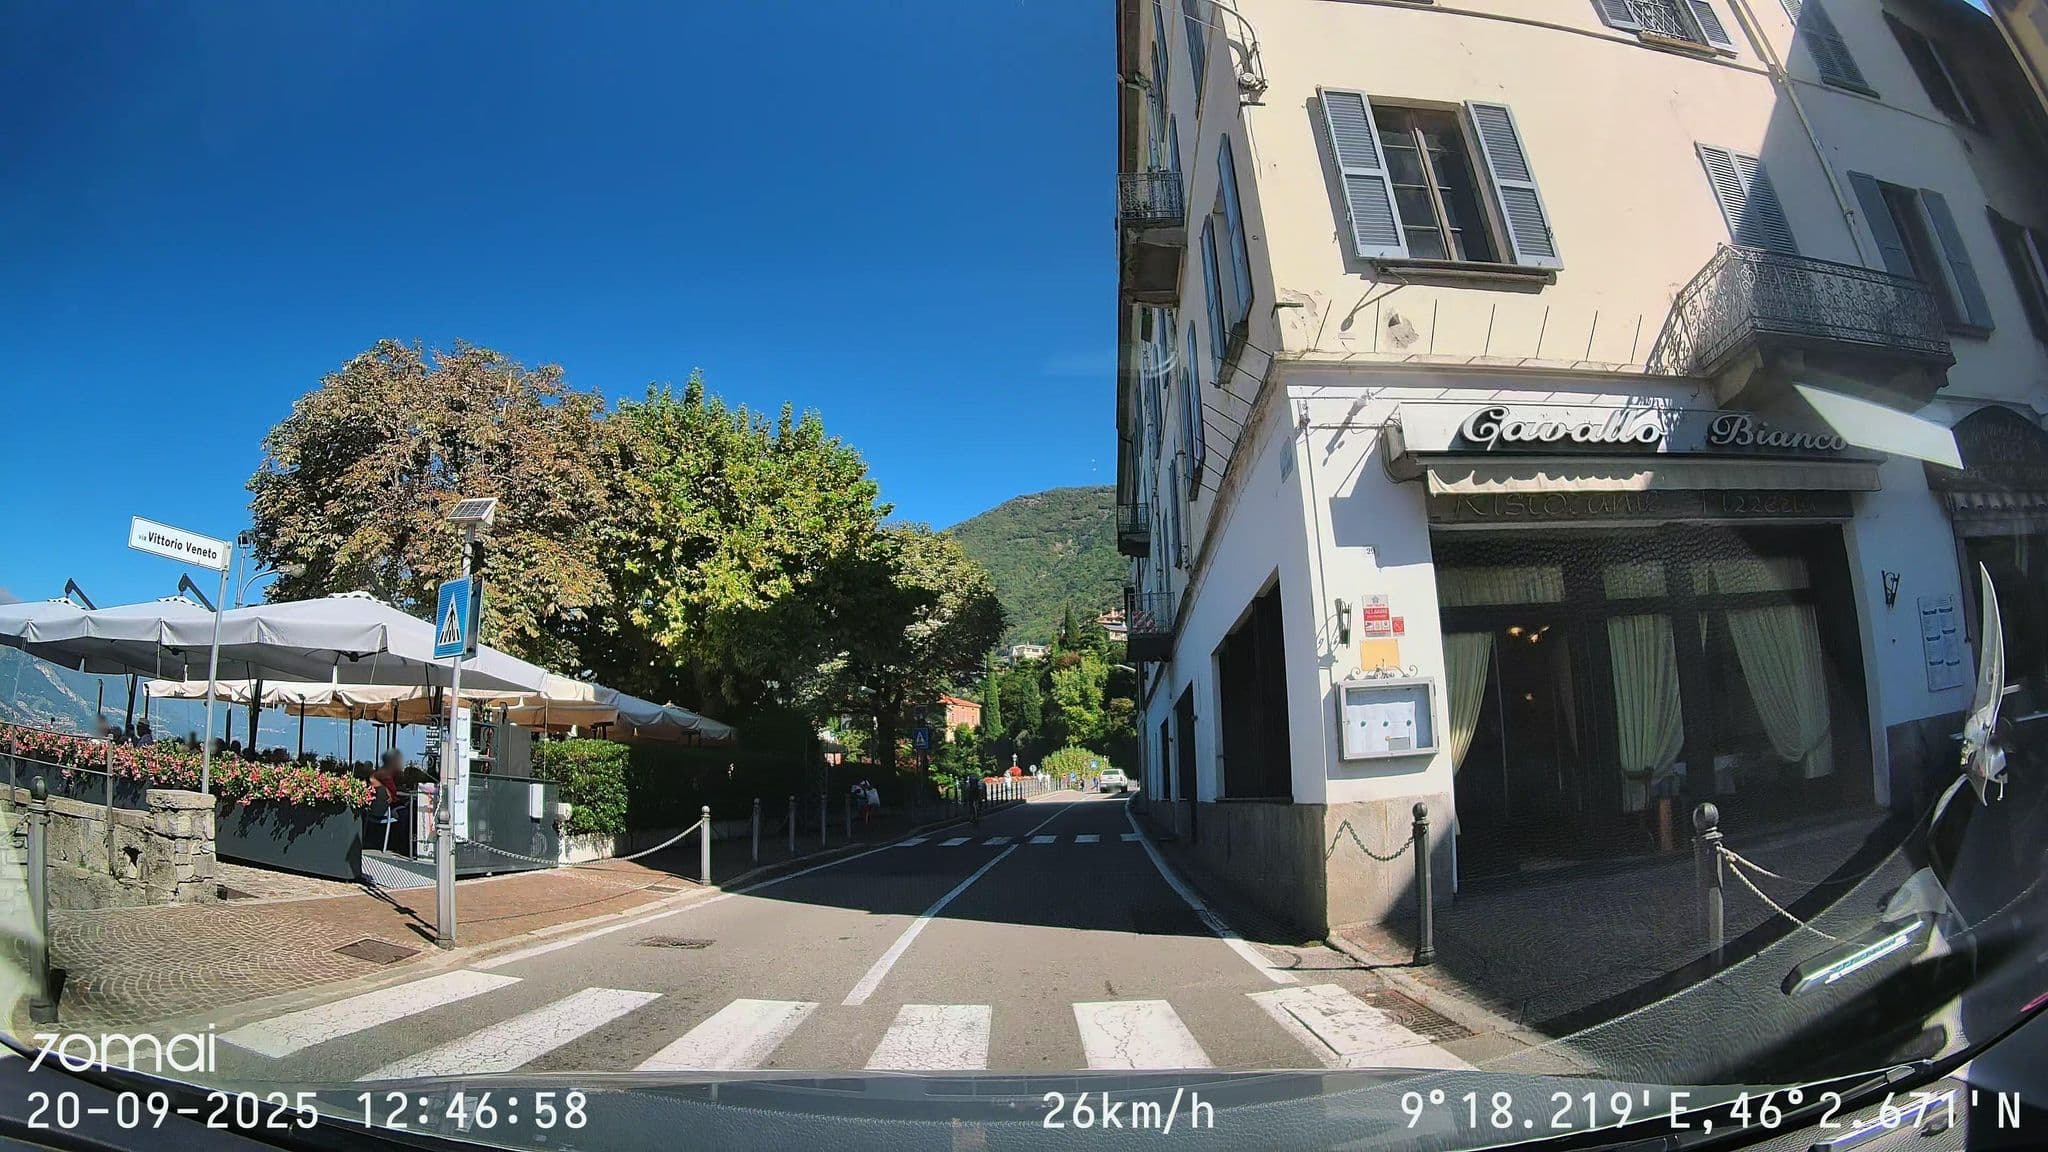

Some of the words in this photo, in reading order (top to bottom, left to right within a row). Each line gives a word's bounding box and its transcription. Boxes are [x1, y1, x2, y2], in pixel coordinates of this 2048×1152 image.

[1710, 414, 1848, 450] Bianco
[148, 531, 183, 550] Vittorio
[186, 541, 217, 559] Veneto
